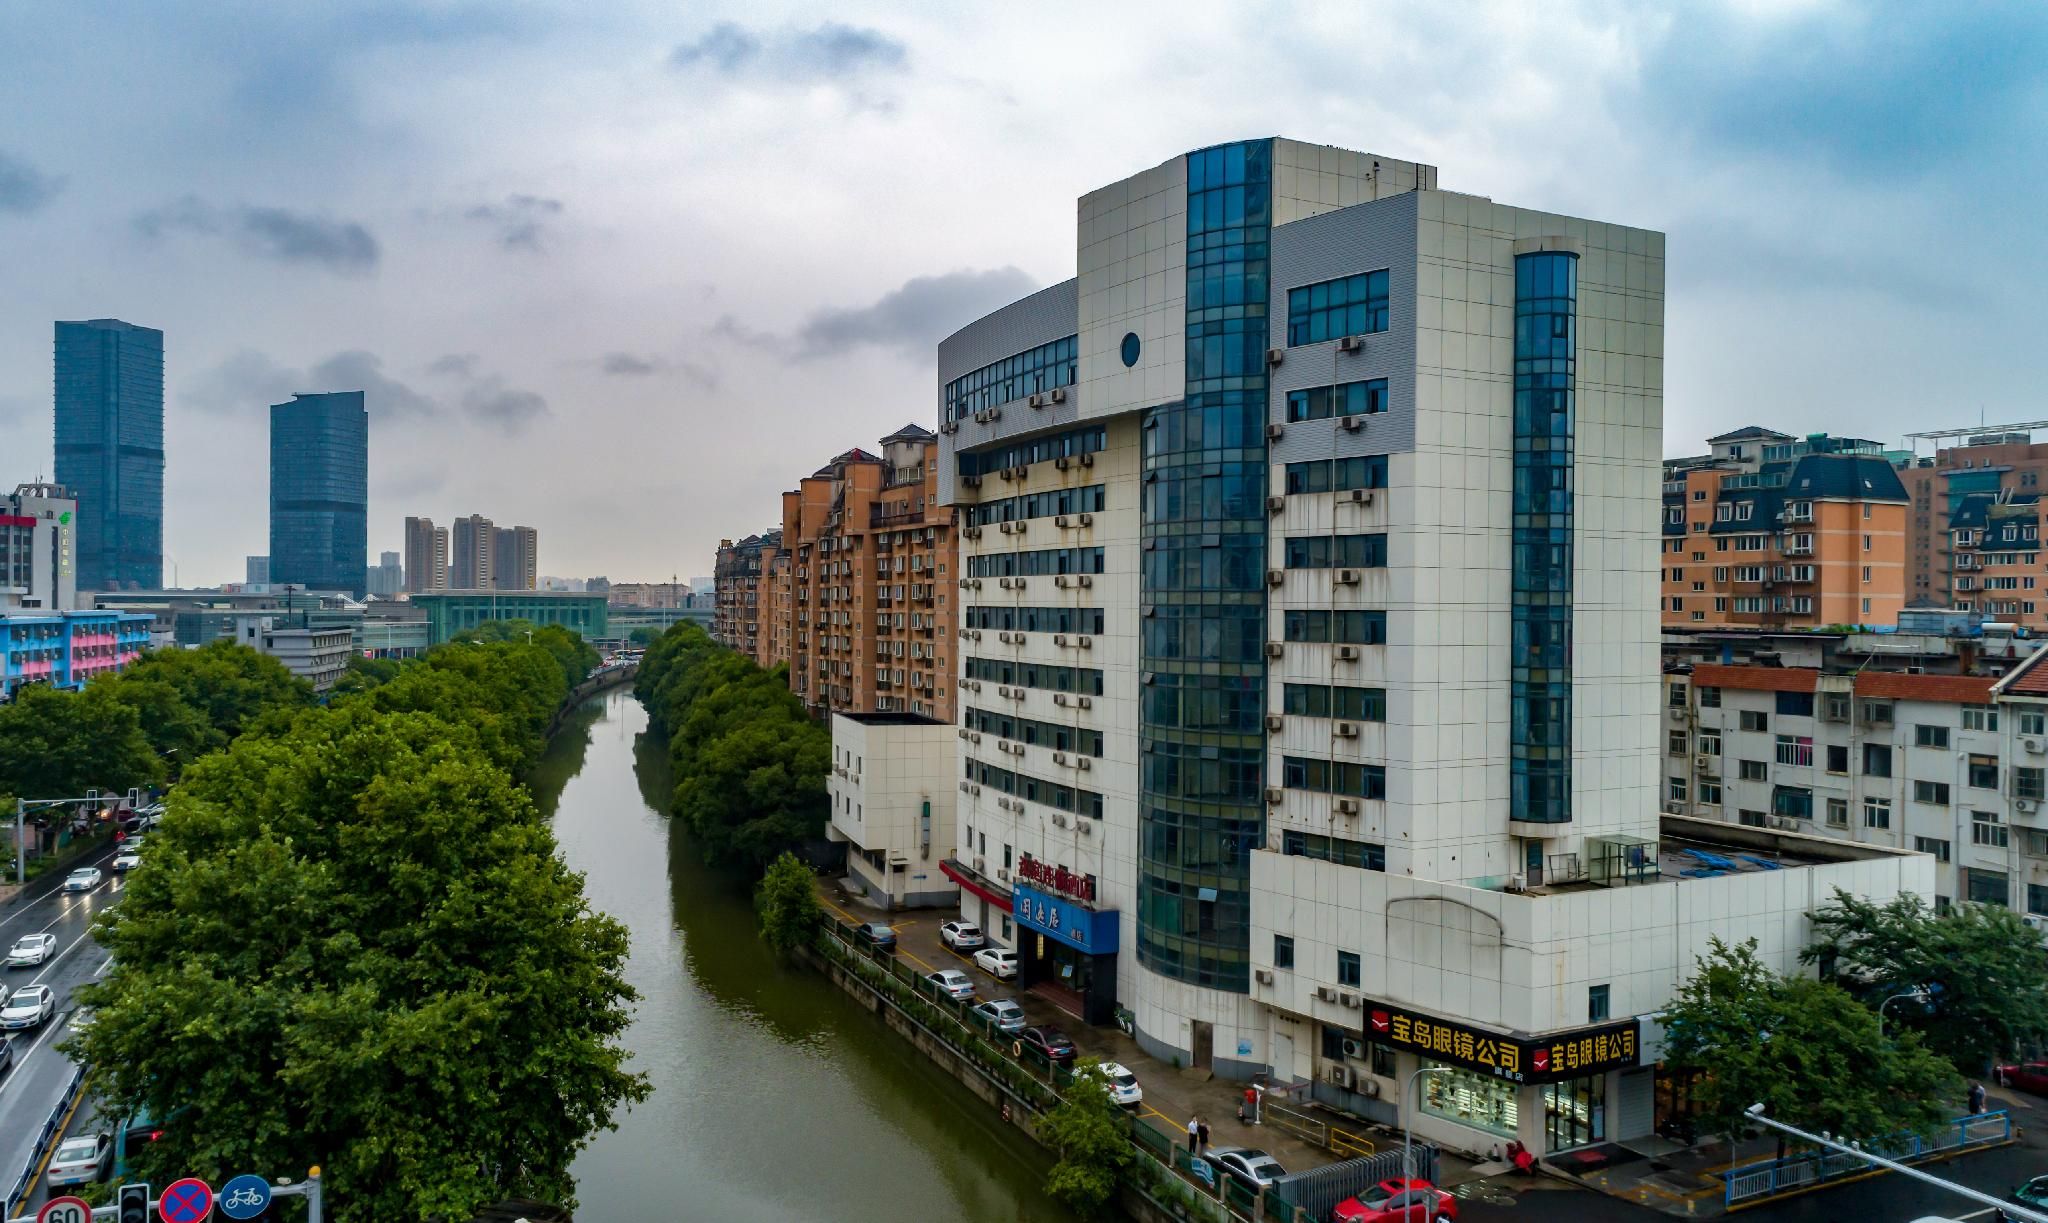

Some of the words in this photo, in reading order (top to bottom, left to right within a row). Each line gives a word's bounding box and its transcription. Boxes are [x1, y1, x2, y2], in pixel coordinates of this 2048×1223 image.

[1392, 1014, 1520, 1073] 宝岛眼镜公司
[1551, 1029, 1635, 1073] 宝岛眼镜公司
[49, 1208, 79, 1223] 60
